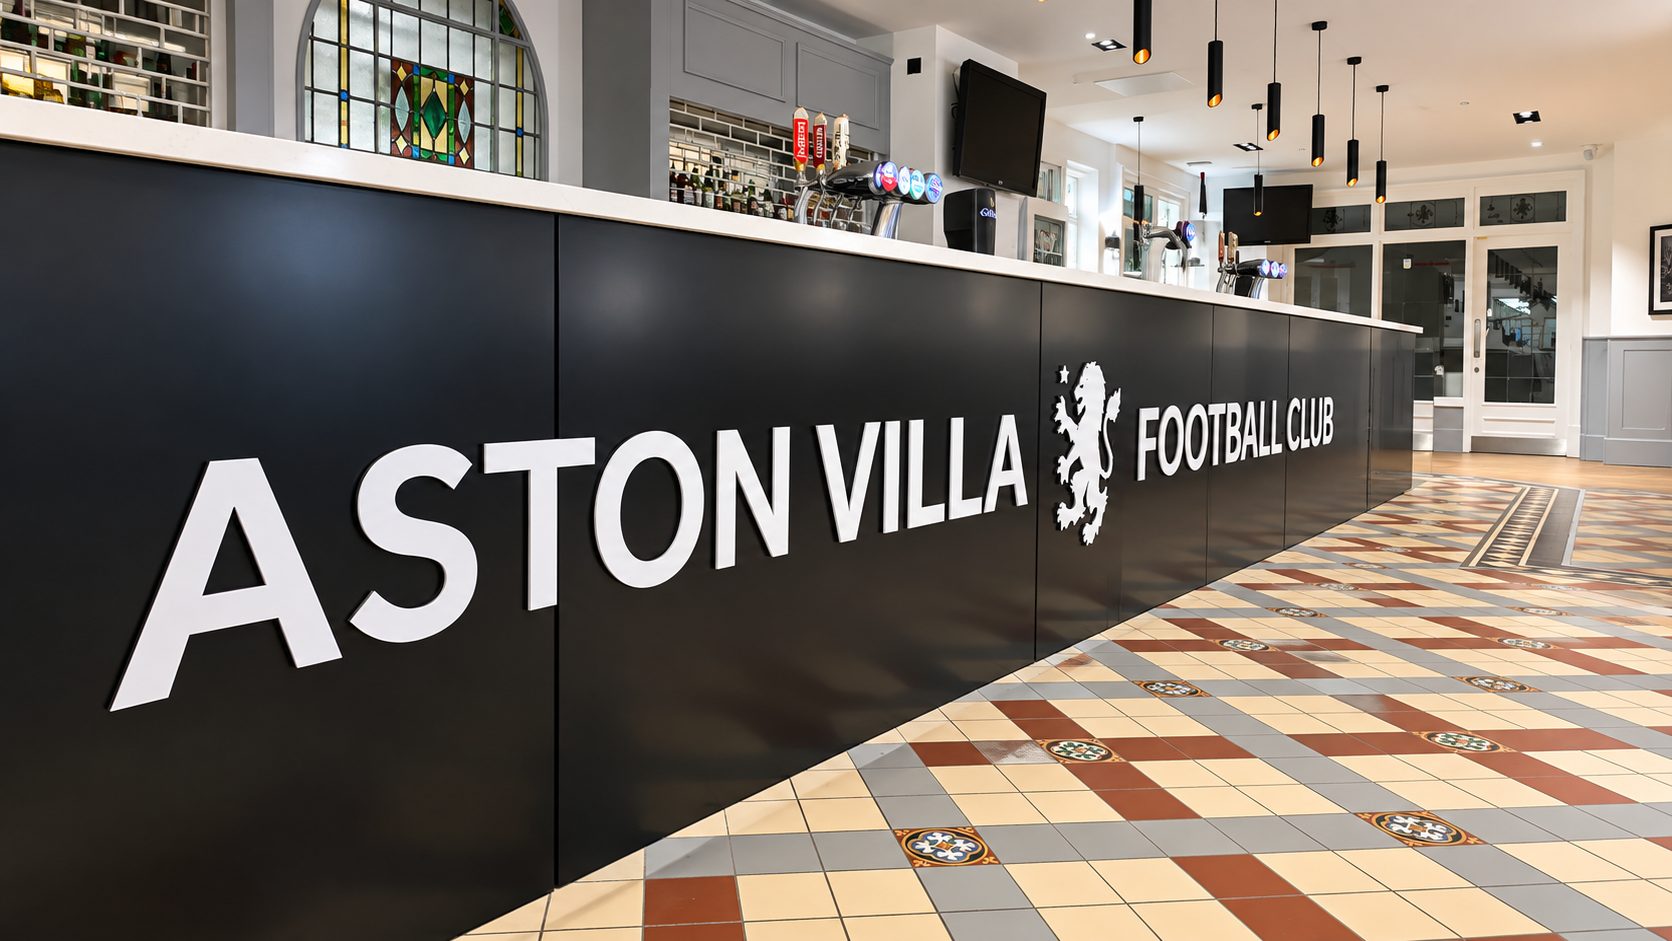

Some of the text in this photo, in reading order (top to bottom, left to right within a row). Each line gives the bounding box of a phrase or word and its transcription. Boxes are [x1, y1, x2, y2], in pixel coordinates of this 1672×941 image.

[1137, 396, 1335, 481] FOOTBALL CLUB
[109, 414, 1029, 712] ASTON VILLA
